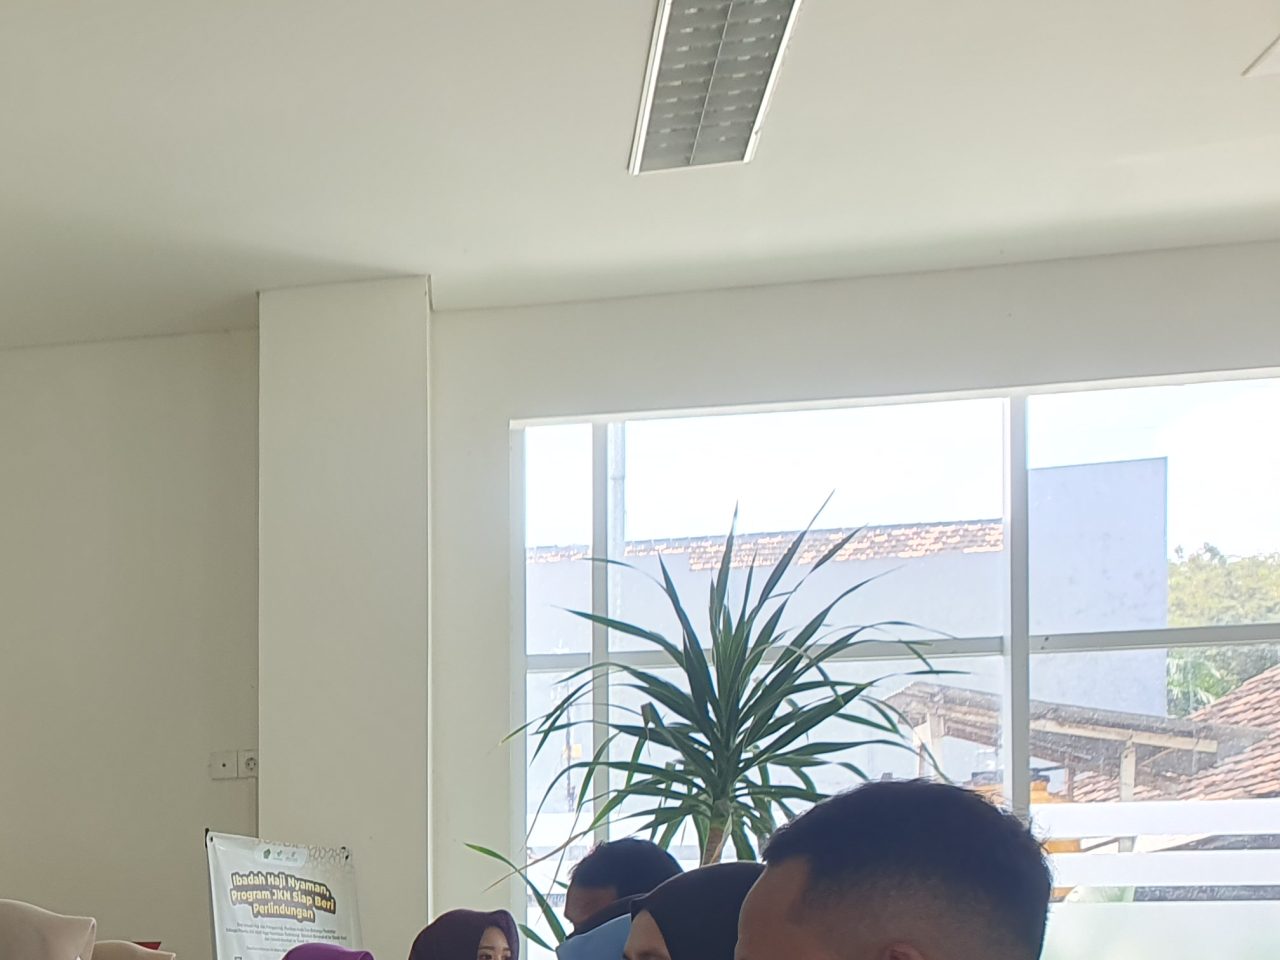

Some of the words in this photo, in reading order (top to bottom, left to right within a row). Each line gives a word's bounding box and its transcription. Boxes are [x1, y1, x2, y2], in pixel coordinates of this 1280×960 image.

[231, 873, 266, 886] Ibadah
[267, 873, 286, 888] Haji
[288, 876, 330, 897] Nyaman,
[230, 889, 271, 902] Program
[272, 889, 291, 901] JKN
[292, 892, 313, 906] Siap
[314, 895, 335, 911] Beri
[253, 902, 314, 919] Perlindungan
